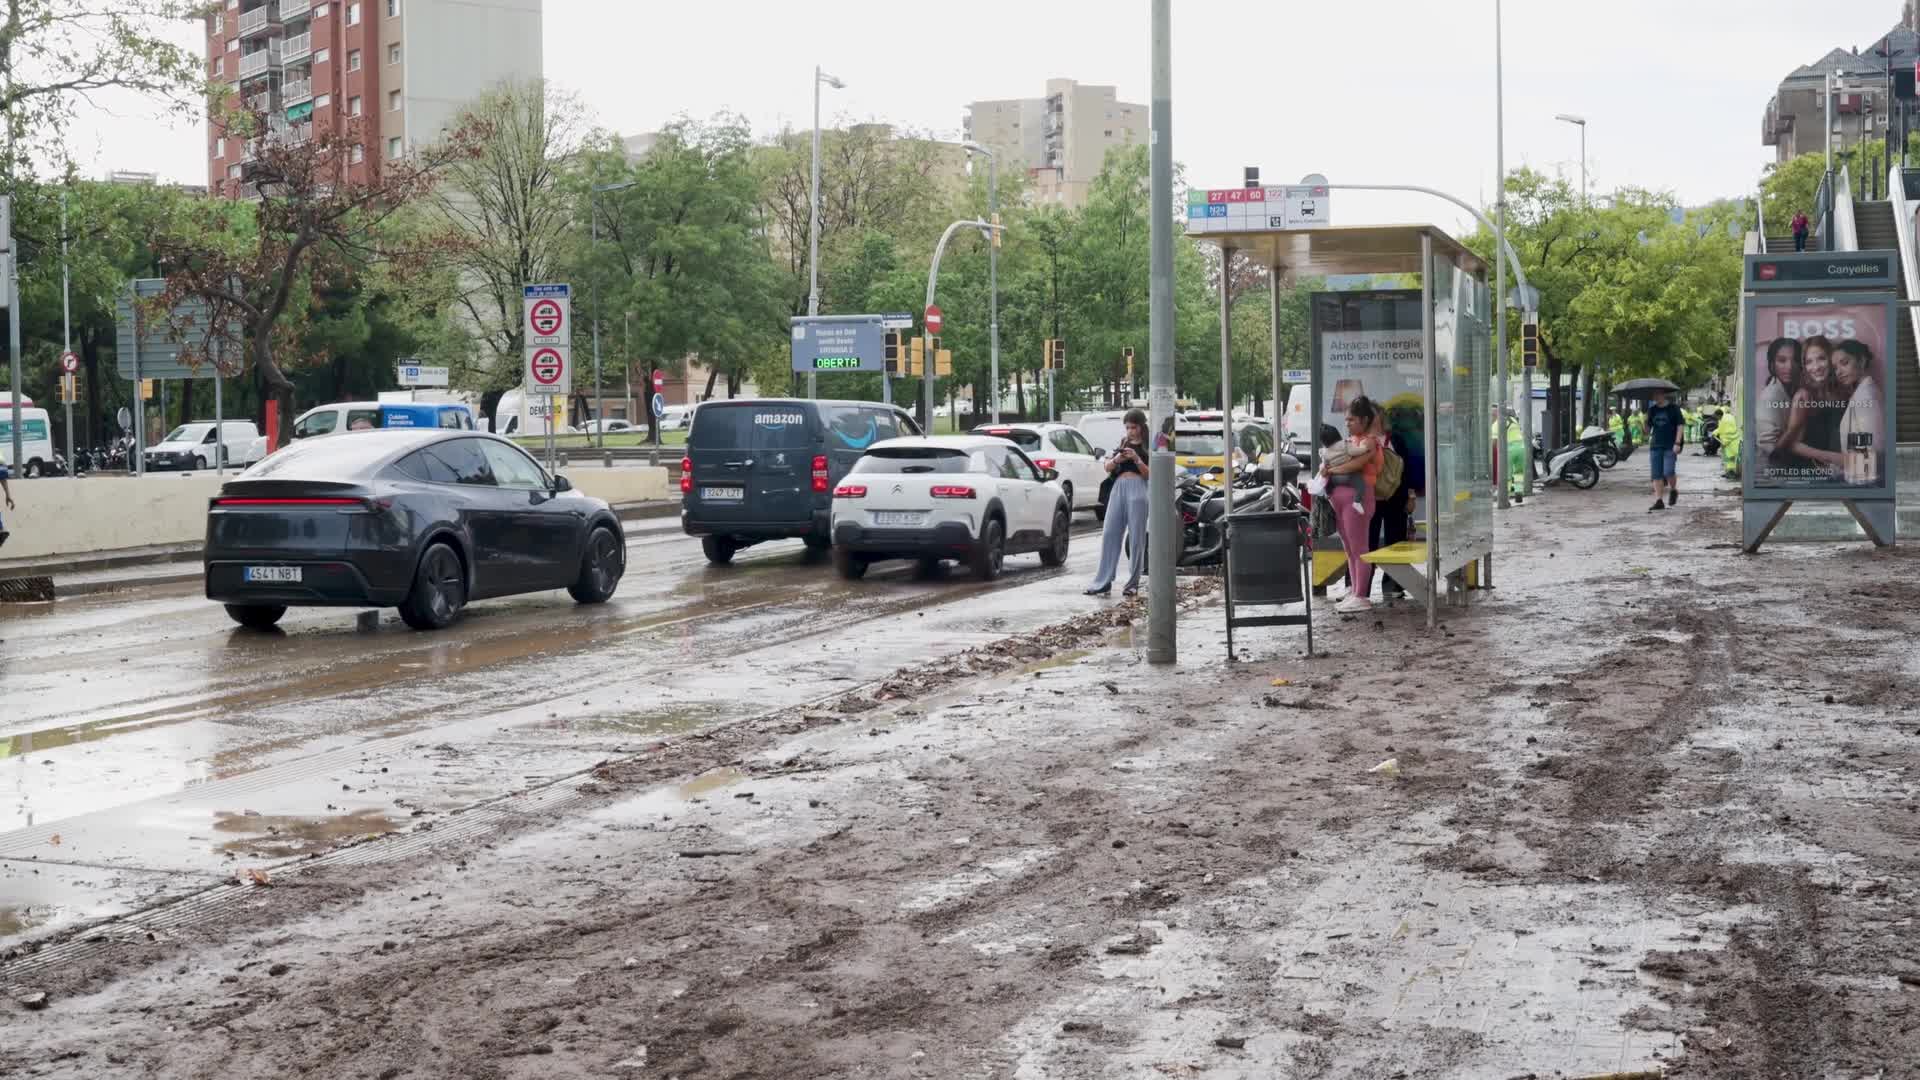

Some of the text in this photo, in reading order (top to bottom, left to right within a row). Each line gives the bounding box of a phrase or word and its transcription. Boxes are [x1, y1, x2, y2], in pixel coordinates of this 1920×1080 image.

[1211, 193, 1222, 201] 27
[1231, 191, 1242, 200] 47
[1250, 191, 1261, 199] 60
[1827, 264, 1880, 277] Canyelles
[1783, 319, 1857, 339] BOSS
[1330, 351, 1354, 361] amb
[1358, 351, 1390, 361] sentit
[817, 358, 858, 368] OBERTA
[754, 413, 803, 425] amazon
[1801, 467, 1833, 476] BEYOND
[250, 568, 298, 579] 4541 NBT
